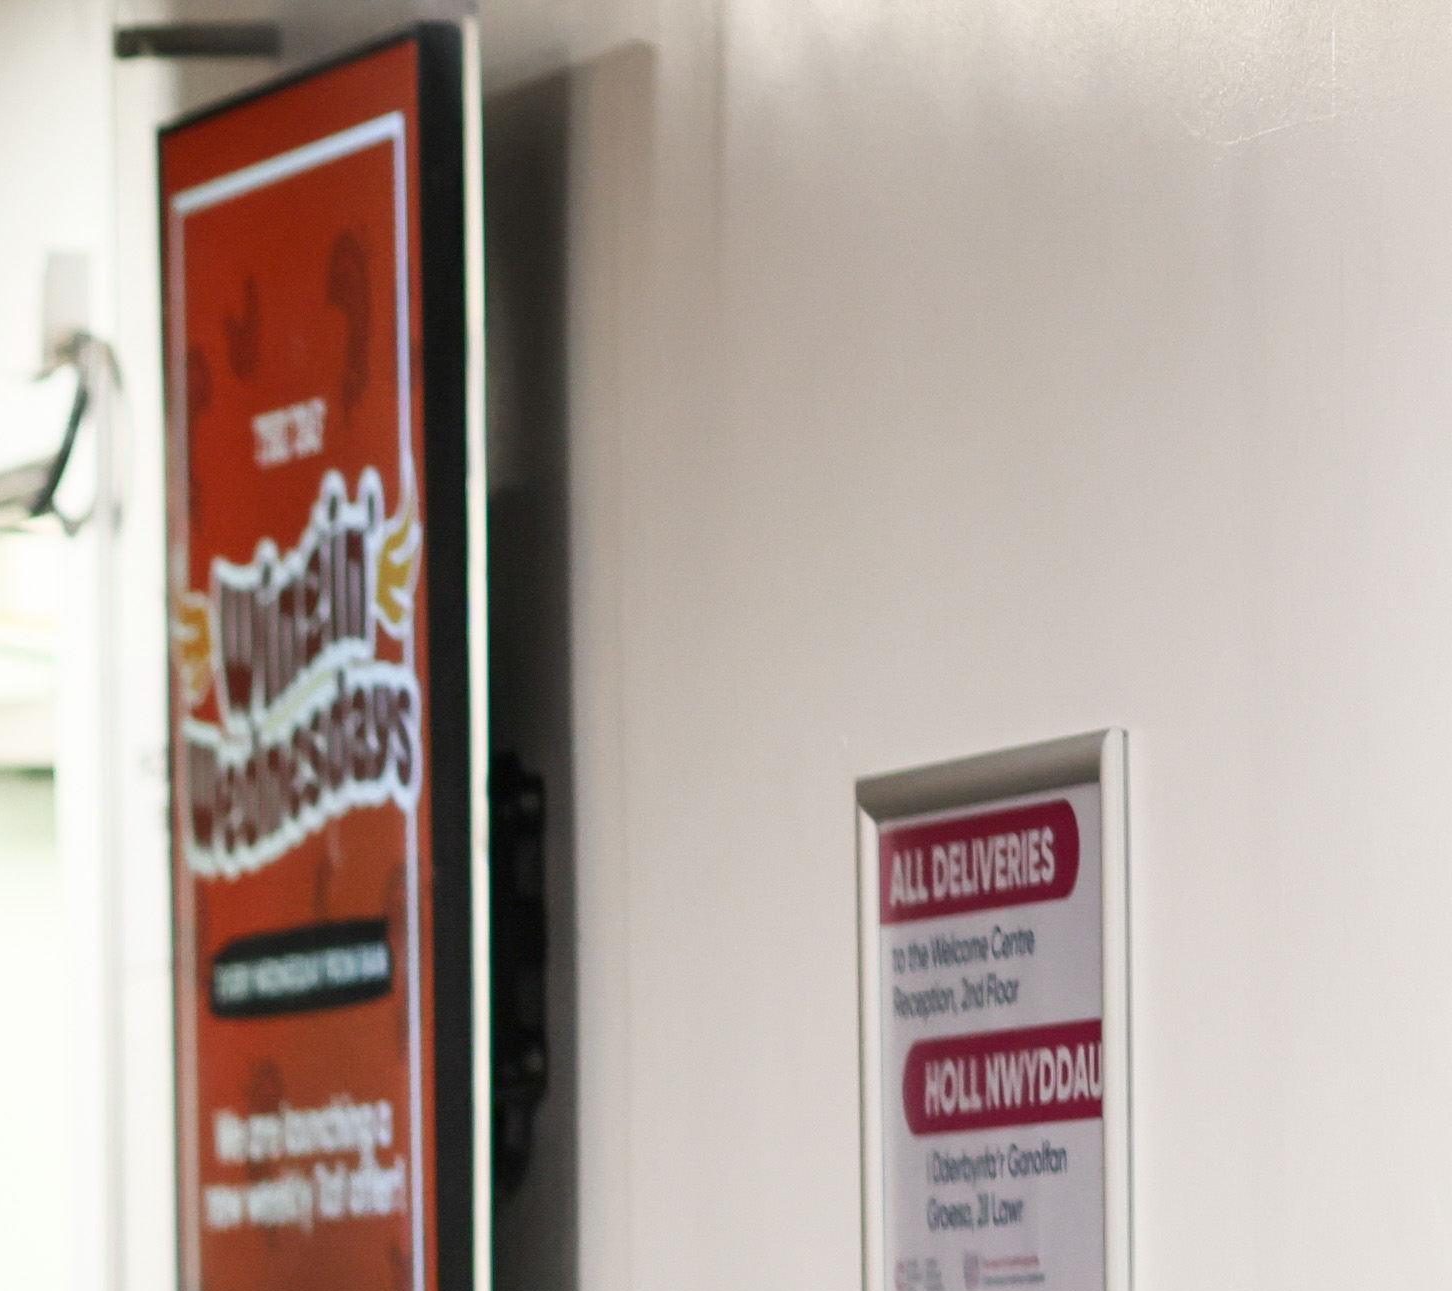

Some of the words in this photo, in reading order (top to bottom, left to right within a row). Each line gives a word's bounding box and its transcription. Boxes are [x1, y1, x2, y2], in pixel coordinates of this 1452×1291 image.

[890, 848, 928, 907] ALL
[931, 826, 1055, 899] DELIVERIES
[908, 938, 928, 971] the
[931, 933, 988, 968] Welcome
[991, 925, 1035, 960] Centre
[987, 972, 1020, 1006] Floor
[925, 1056, 982, 1117] HOLL
[985, 1041, 1102, 1110] NWYDDAU
[1007, 1139, 1068, 1178] Ganolfan
